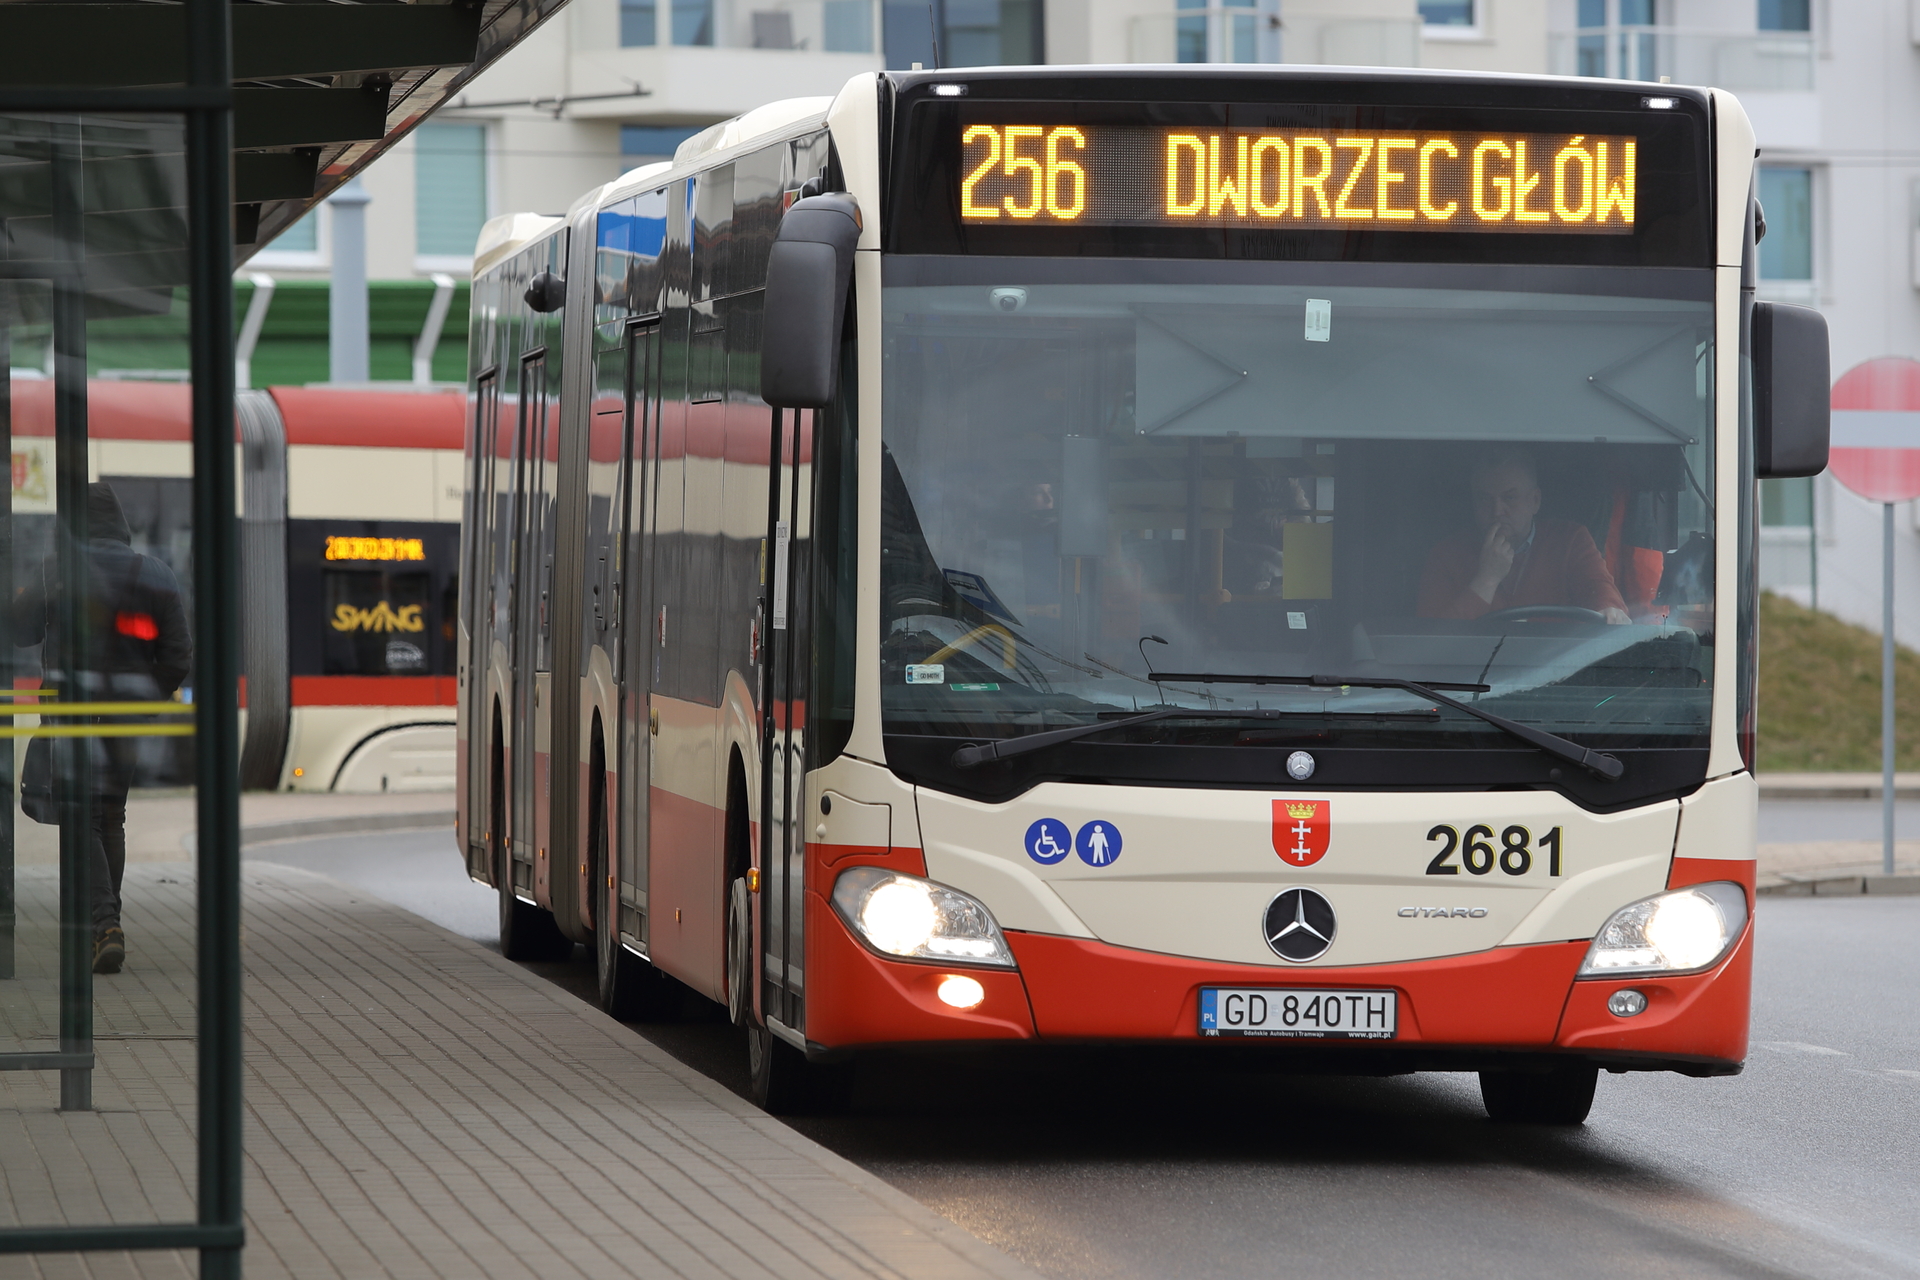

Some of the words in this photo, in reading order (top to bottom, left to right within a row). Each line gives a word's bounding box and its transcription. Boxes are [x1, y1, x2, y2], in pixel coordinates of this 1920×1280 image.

[961, 124, 1086, 222] 256
[1165, 134, 1459, 222] DWORZEC
[1472, 135, 1636, 224] GŁÓW
[331, 601, 424, 632] SWING
[1425, 823, 1565, 878] 2681
[1397, 906, 1489, 919] CITARO
[1203, 1013, 1215, 1022] PL
[1225, 993, 1268, 1027] GD
[1282, 995, 1386, 1029] 840TH
